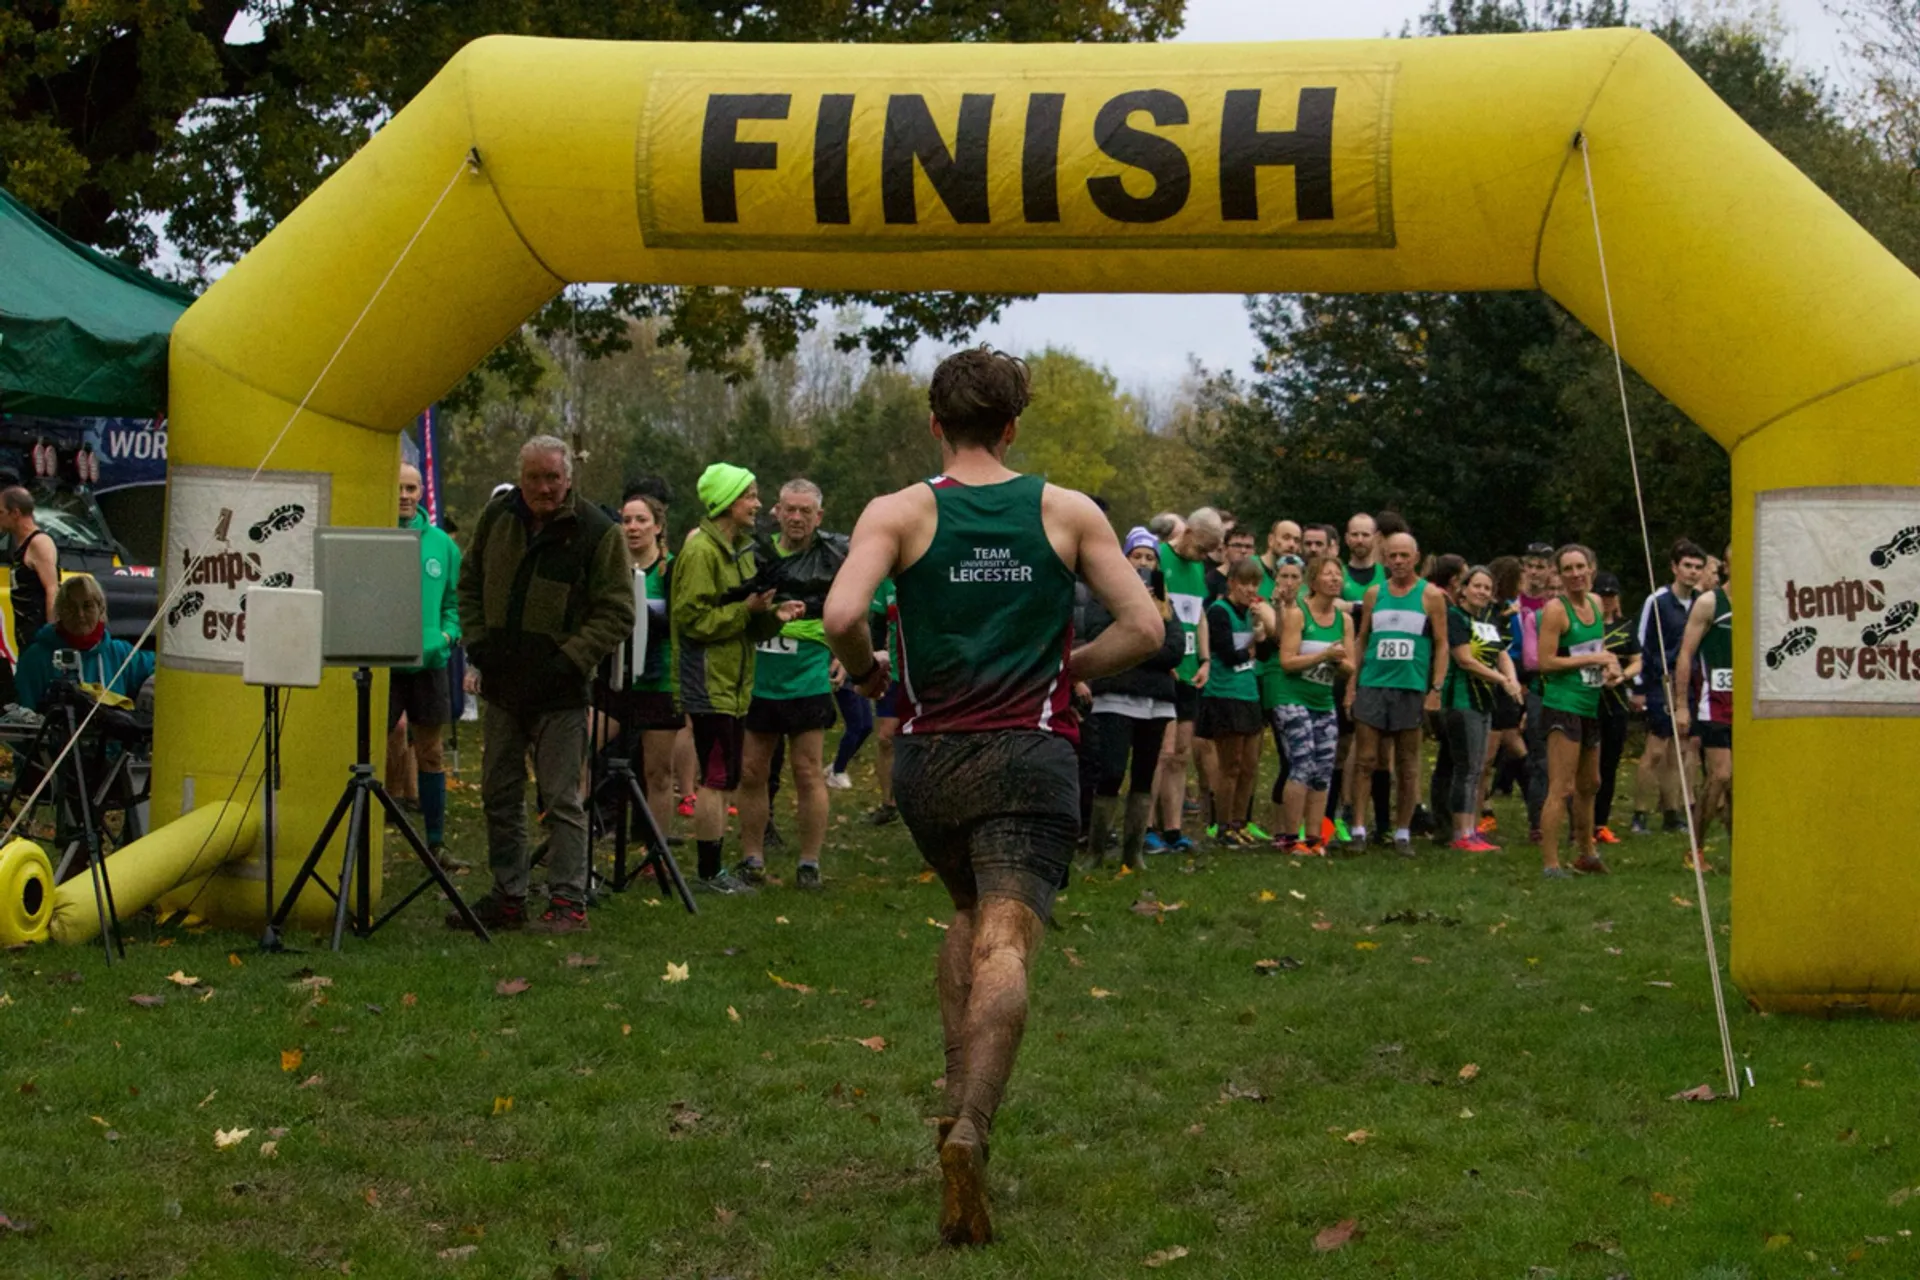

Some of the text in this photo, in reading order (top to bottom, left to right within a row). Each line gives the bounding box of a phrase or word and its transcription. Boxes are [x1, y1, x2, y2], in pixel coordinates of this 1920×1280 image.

[700, 87, 1337, 225] FINISH
[110, 430, 168, 460] WOR
[183, 547, 261, 590] tempo
[960, 560, 1005, 568] UNIVERSITY
[973, 547, 1011, 560] TEAM
[949, 566, 1032, 582] LEICESTER
[1785, 579, 1885, 622] tempo
[1380, 641, 1409, 658] 28 D
[1816, 640, 1920, 680] events
